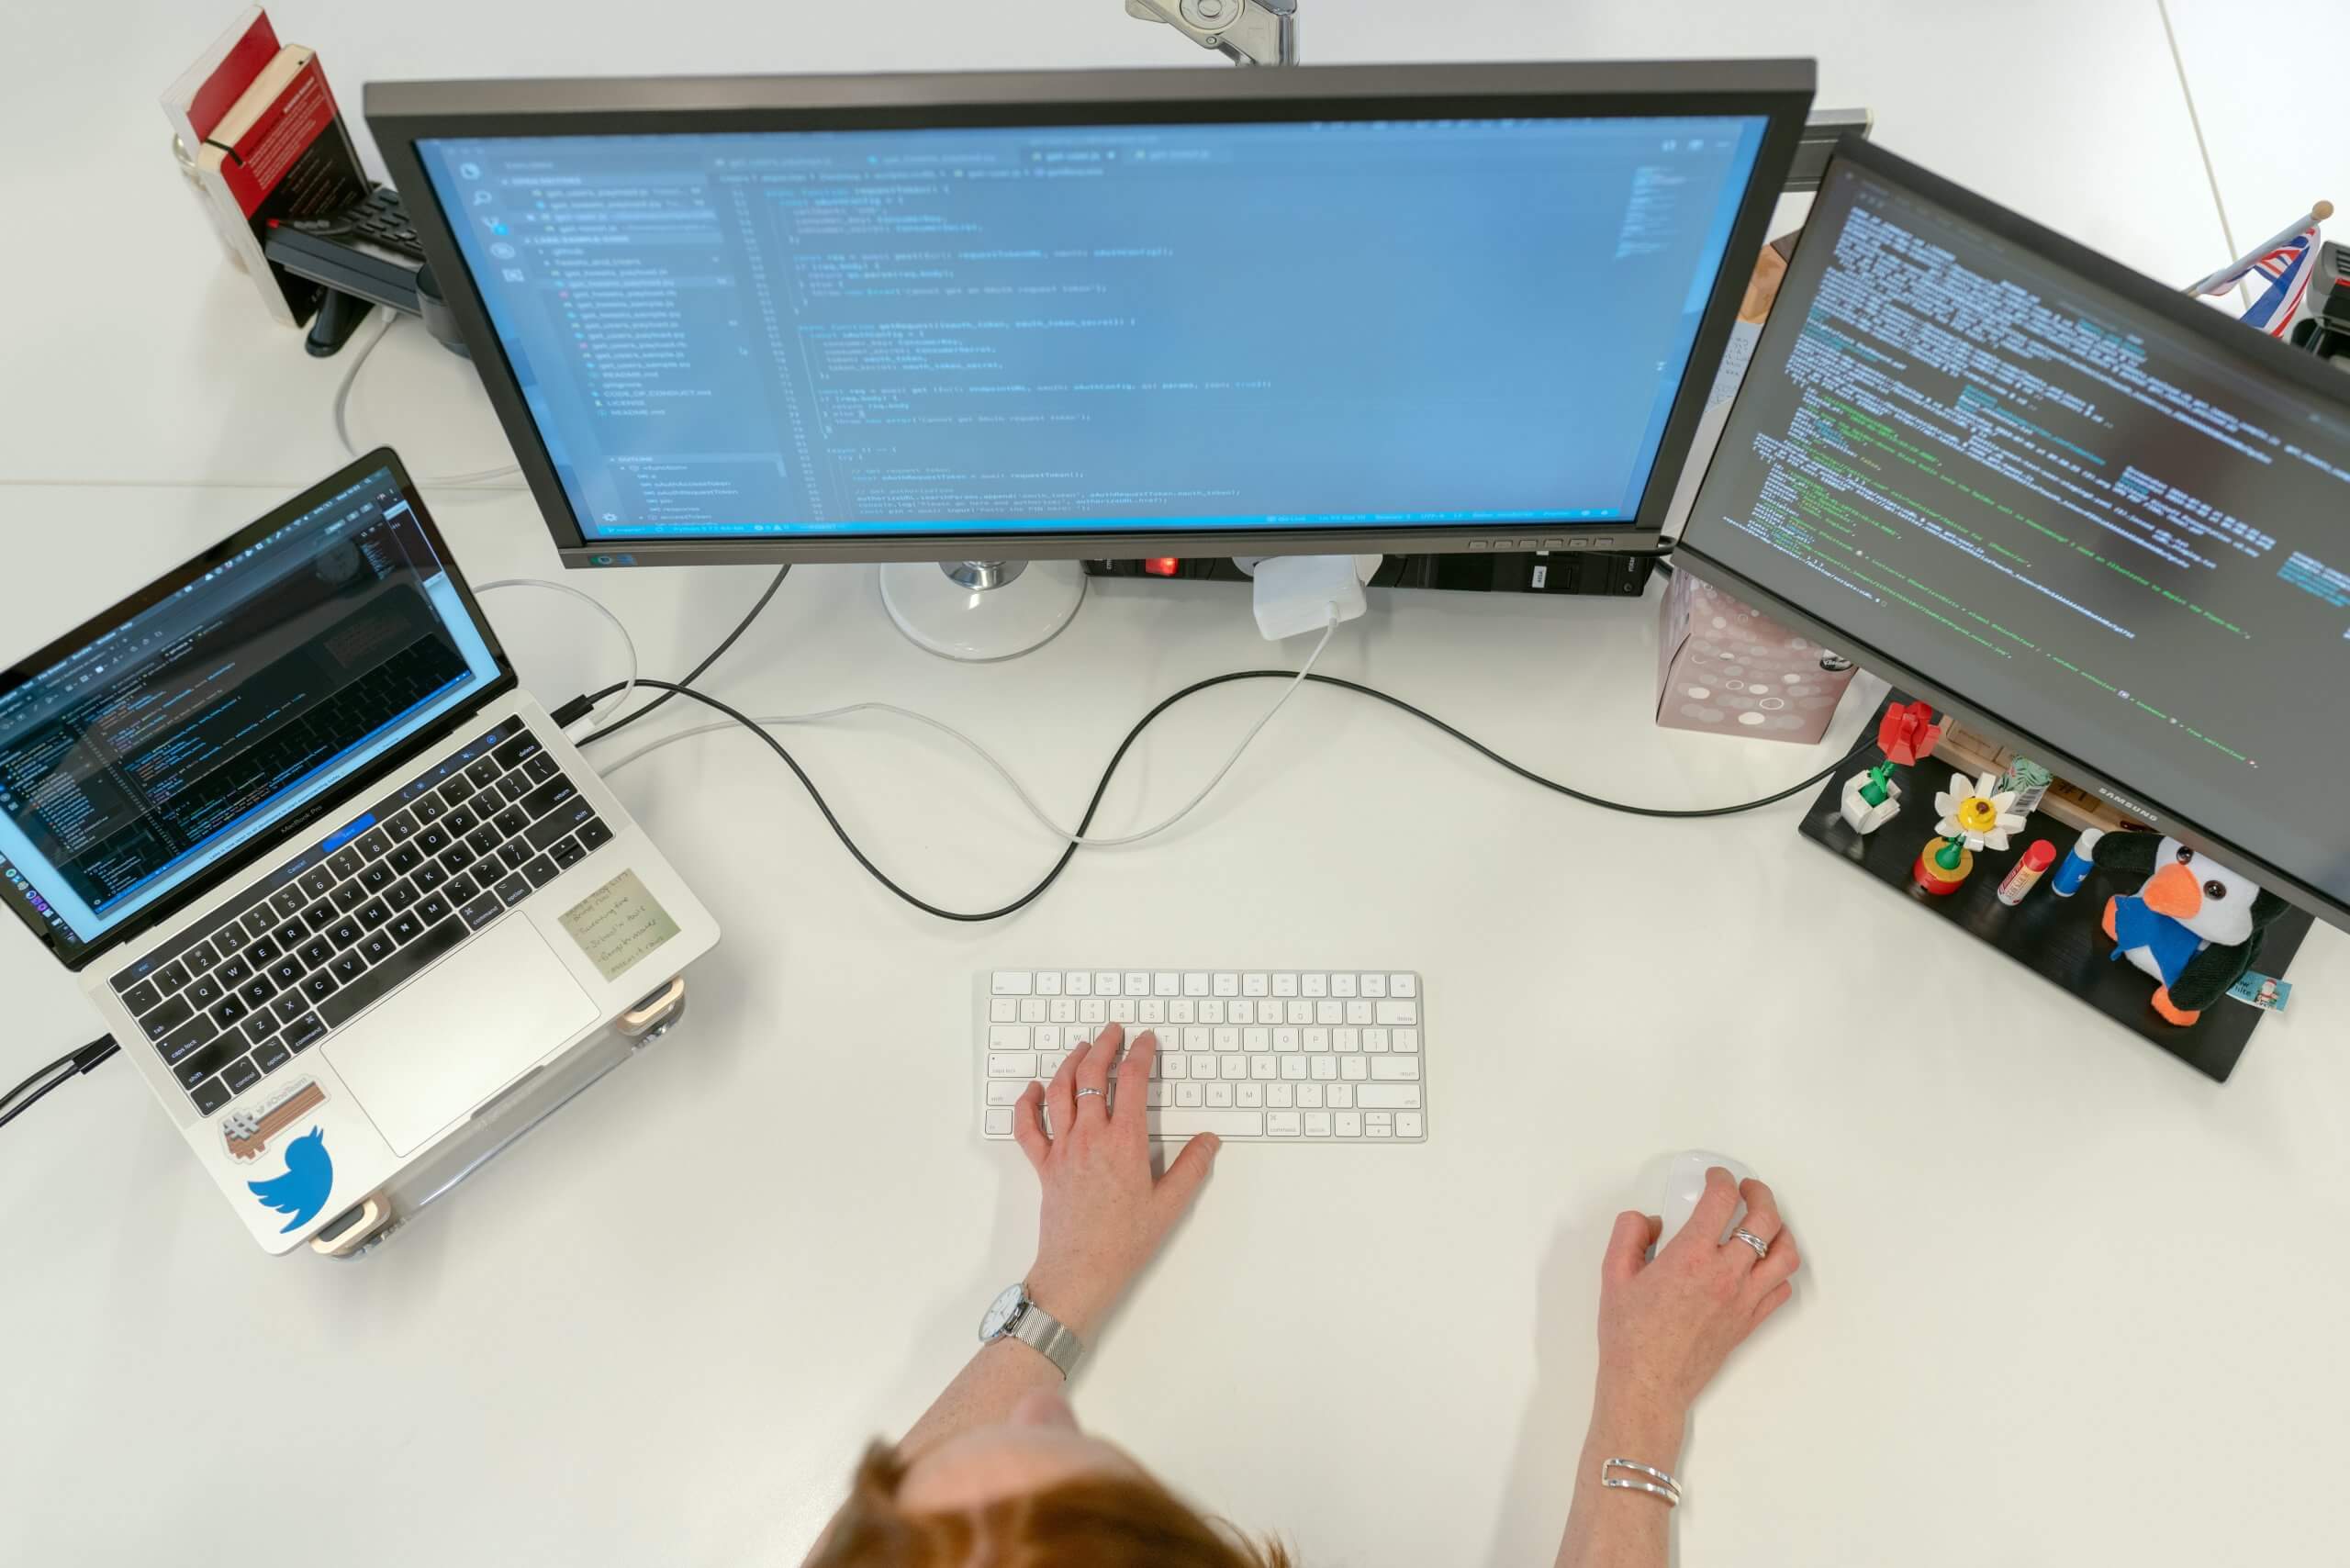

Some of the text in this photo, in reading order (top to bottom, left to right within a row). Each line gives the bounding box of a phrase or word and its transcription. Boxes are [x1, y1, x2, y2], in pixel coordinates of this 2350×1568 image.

[2098, 787, 2158, 823] SAMSUNG
[281, 805, 323, 834] MacBook Pro
[453, 854, 461, 862] L
[373, 872, 381, 880] U
[425, 872, 433, 880] K
[400, 890, 405, 899] J
[428, 904, 438, 913] M
[368, 910, 377, 918] H
[400, 924, 409, 932] N
[341, 929, 349, 937] G
[373, 943, 380, 951] B
[343, 961, 351, 969] V
[228, 968, 238, 976] W
[283, 968, 291, 976] D
[315, 981, 323, 990] C
[254, 987, 263, 995] S
[285, 1001, 294, 1010] X
[256, 1021, 264, 1029] Z
